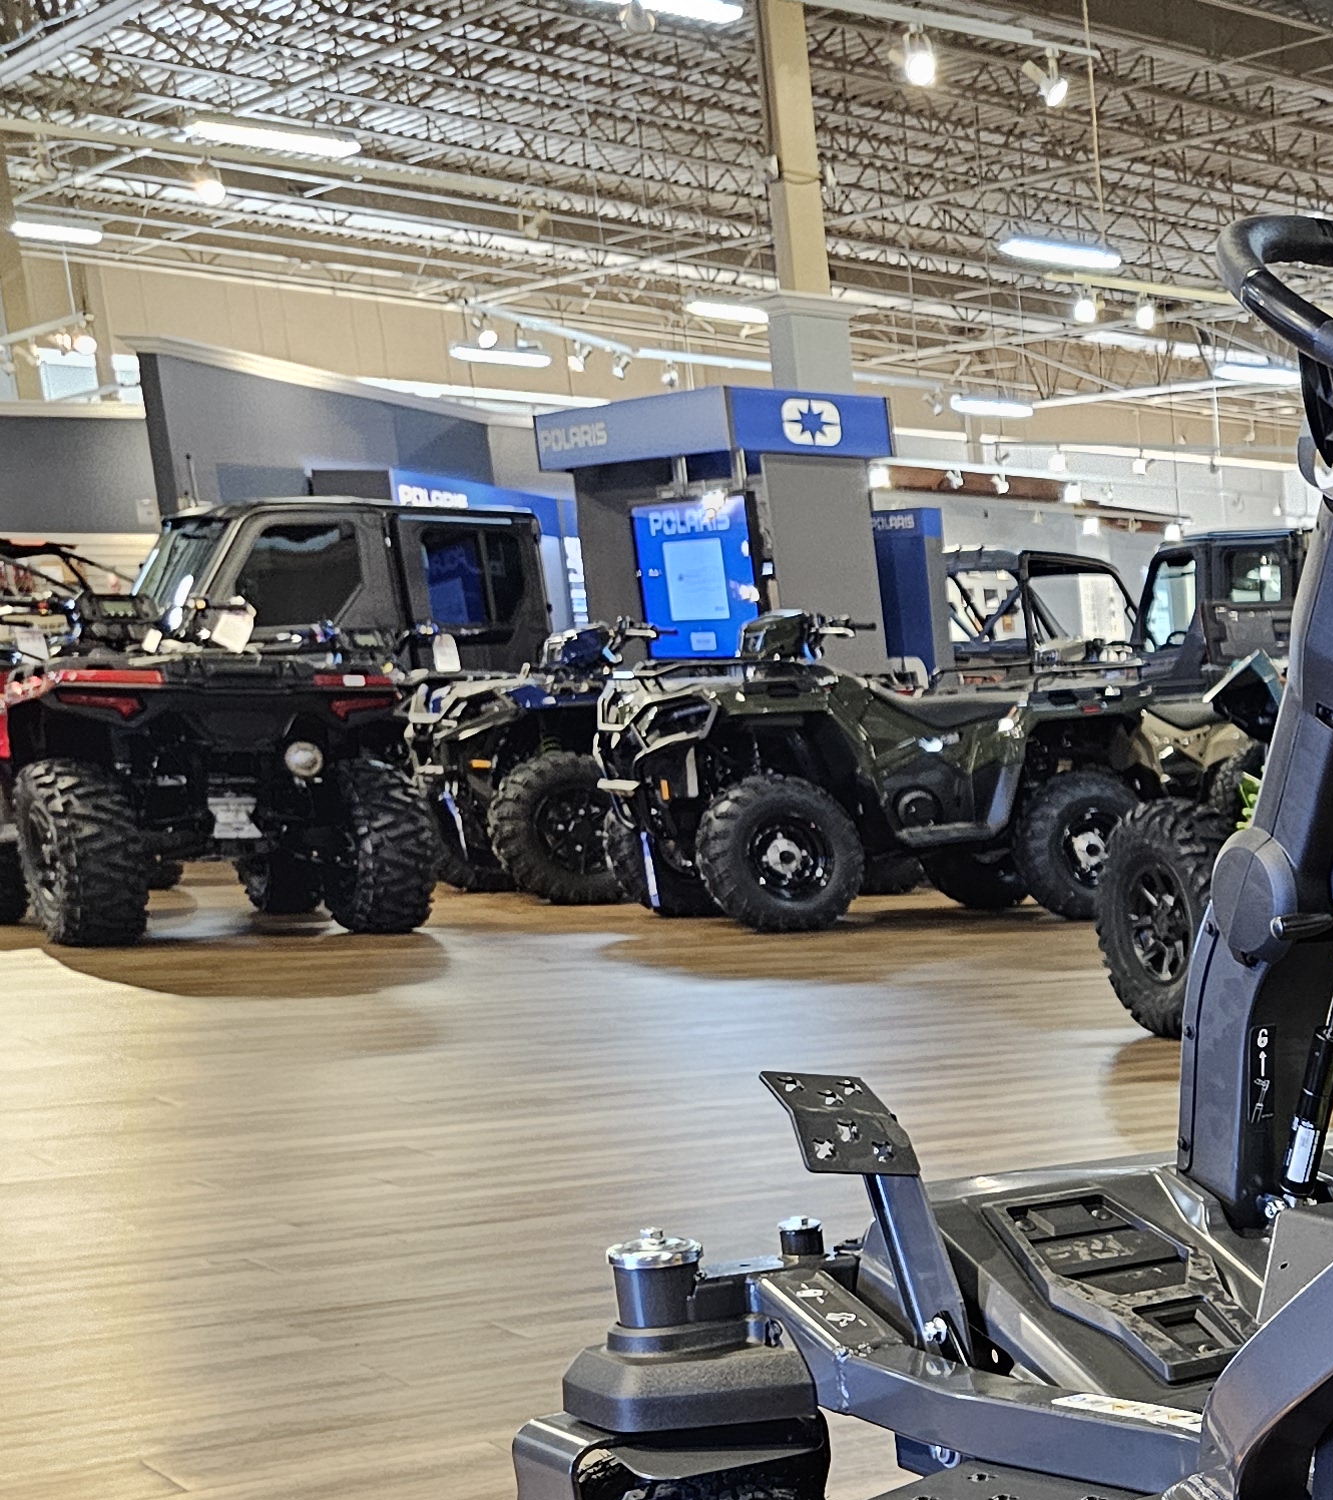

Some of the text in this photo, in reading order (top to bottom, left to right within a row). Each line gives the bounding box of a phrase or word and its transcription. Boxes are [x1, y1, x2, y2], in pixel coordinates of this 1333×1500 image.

[540, 421, 608, 453] POLARIS
[397, 484, 469, 508] POLARIS
[648, 510, 731, 537] POLARIS
